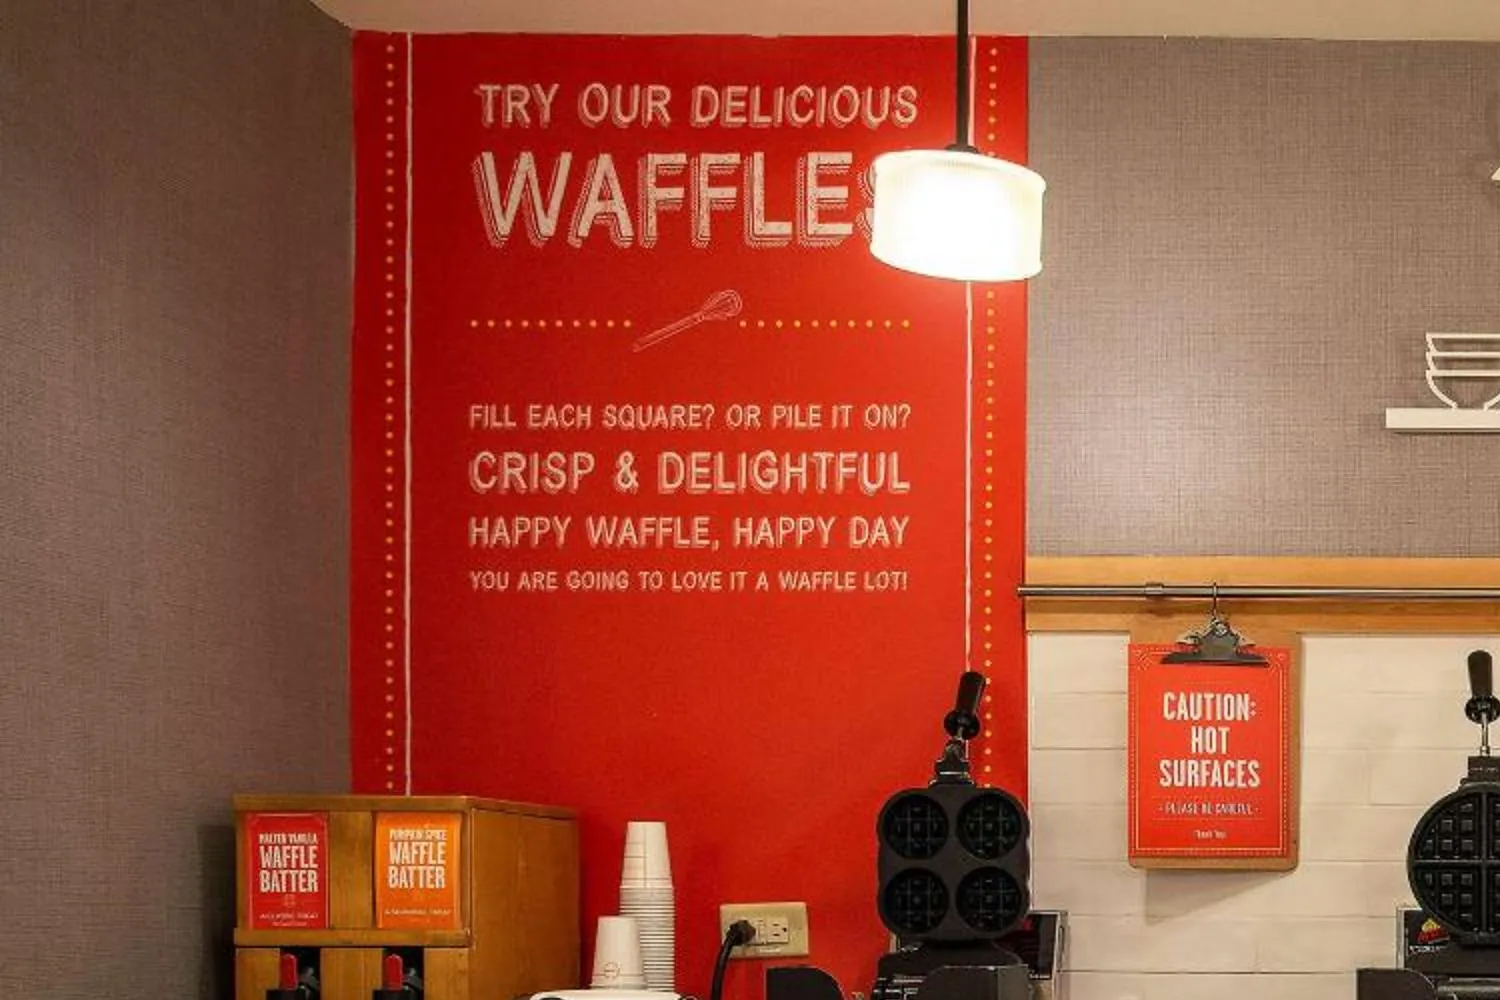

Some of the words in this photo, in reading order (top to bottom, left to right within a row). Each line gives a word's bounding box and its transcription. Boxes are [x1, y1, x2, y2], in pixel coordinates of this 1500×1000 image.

[474, 83, 560, 129] TRY
[577, 83, 672, 129] OUR
[690, 84, 920, 131] DELICIOUS
[473, 151, 873, 249] WAFFLE
[470, 404, 517, 430] FILL
[527, 404, 592, 430] EACH
[602, 403, 715, 430] SQUARE?
[725, 403, 761, 430] OR
[771, 404, 823, 430] PILE
[830, 404, 854, 430] IT
[863, 403, 912, 430] ON?
[469, 450, 596, 494] CRISP
[613, 450, 640, 493] &
[657, 449, 912, 497] DELIGHTFUL
[470, 516, 572, 548] HAPPY
[587, 516, 720, 551] WAFFLE,
[732, 516, 836, 549] HAPPY
[848, 516, 911, 549] DAY
[470, 570, 510, 591] YOU
[517, 570, 558, 591] ARE
[566, 570, 630, 592] GOING
[638, 570, 663, 592] TO
[671, 570, 723, 592] LOVE
[730, 570, 748, 592] IT
[755, 570, 770, 592] A
[778, 570, 857, 592] WAFFLE
[863, 570, 908, 592] LOT!
[1163, 691, 1256, 722] CAUTION:
[1191, 726, 1230, 755] HOT
[1159, 759, 1260, 788] SURFACES
[259, 845, 319, 869] WAFFLE
[389, 841, 447, 865] WAFFLE
[259, 869, 319, 894] BATTER
[388, 865, 446, 889] BATTER
